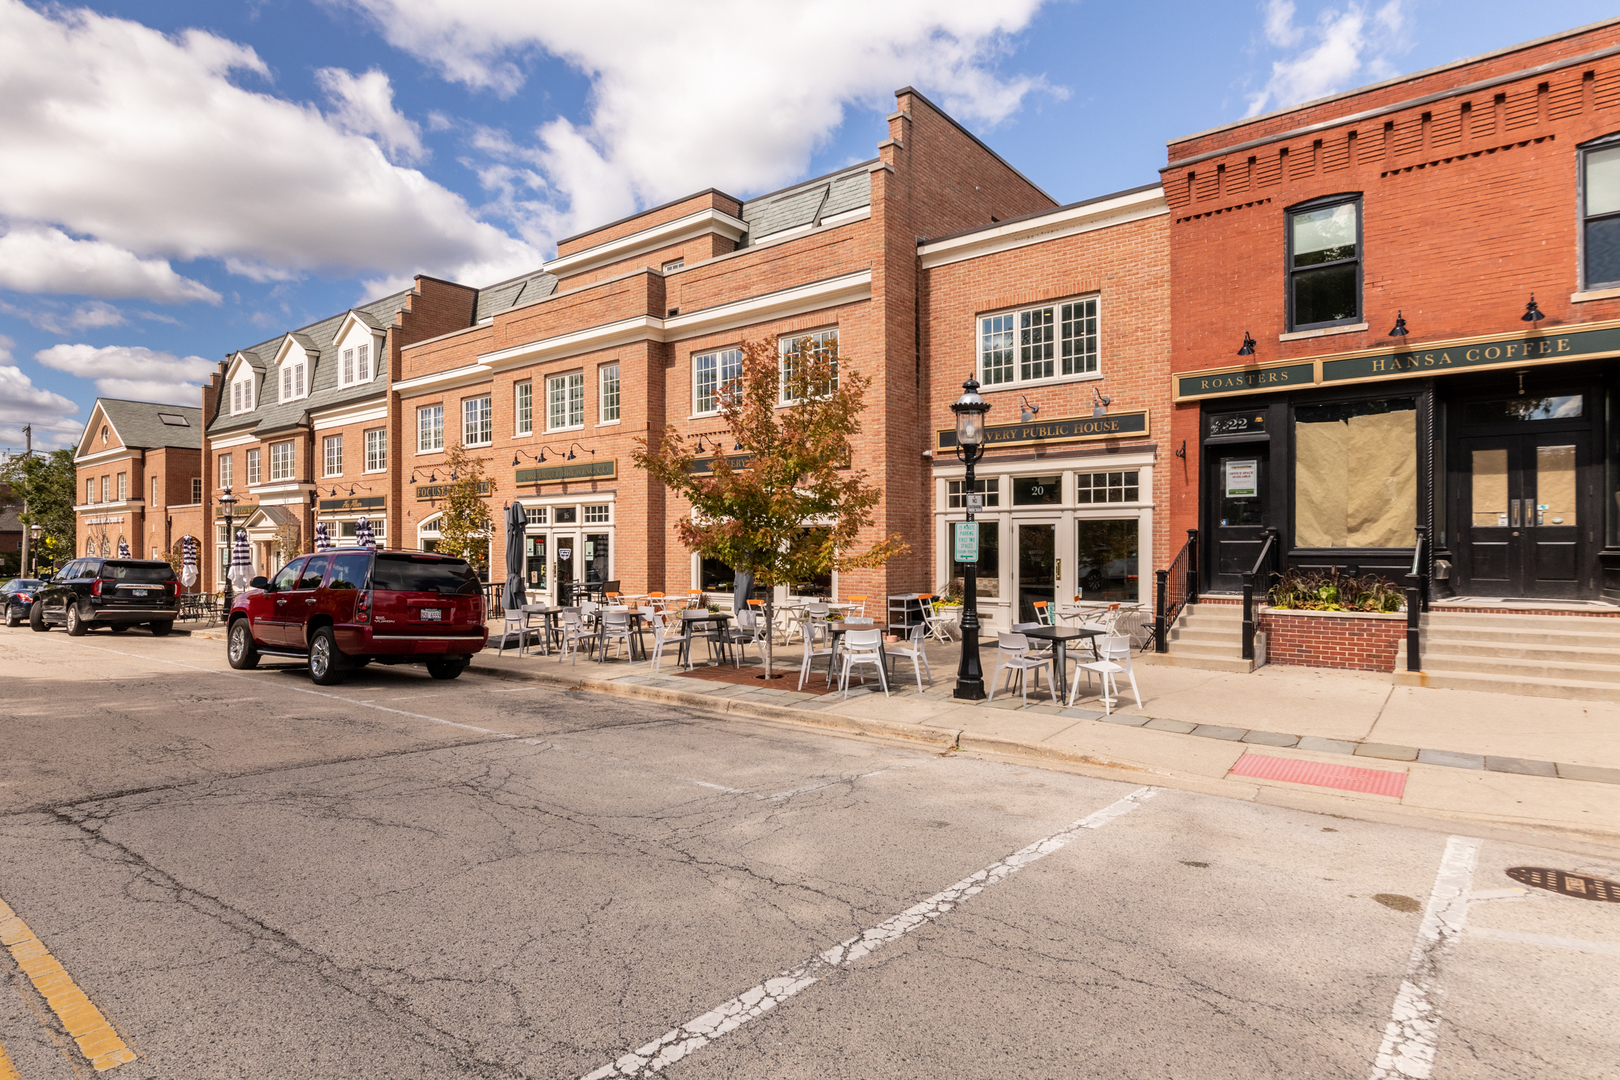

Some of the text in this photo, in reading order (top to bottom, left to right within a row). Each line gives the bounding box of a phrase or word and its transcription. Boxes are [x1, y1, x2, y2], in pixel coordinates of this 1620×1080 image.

[1372, 338, 1571, 372] HANSA COFFEE
[1201, 371, 1289, 390] ROASTERS
[1022, 425, 1068, 438] PUBLIC
[1073, 420, 1120, 434] HOUSE
[539, 470, 559, 479] BLUFF
[562, 467, 596, 477] BREWING
[1031, 485, 1045, 496] 20
